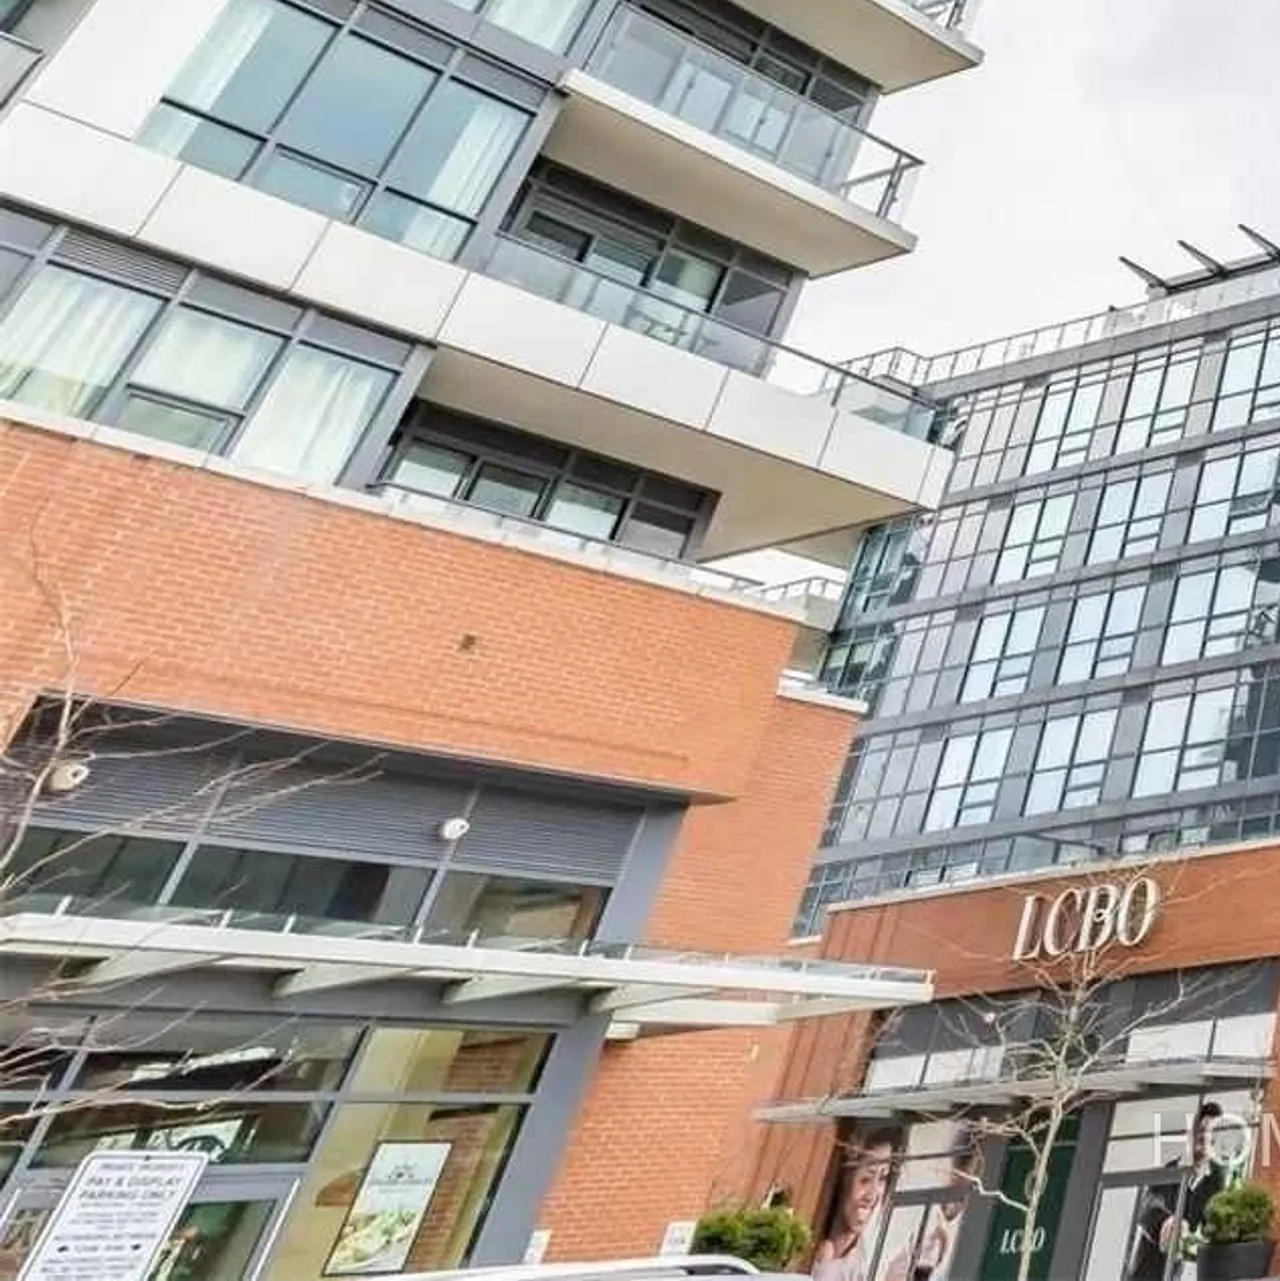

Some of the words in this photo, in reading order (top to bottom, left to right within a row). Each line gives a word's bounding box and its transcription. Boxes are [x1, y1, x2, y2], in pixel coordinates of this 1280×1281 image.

[1012, 877, 1160, 961] LCBO
[87, 1177, 112, 1186] PAY
[127, 1177, 181, 1186] DISPLAY
[79, 1190, 136, 1199] PARKING
[140, 1190, 175, 1199] ONLY
[1000, 1226, 1046, 1253] LCO
